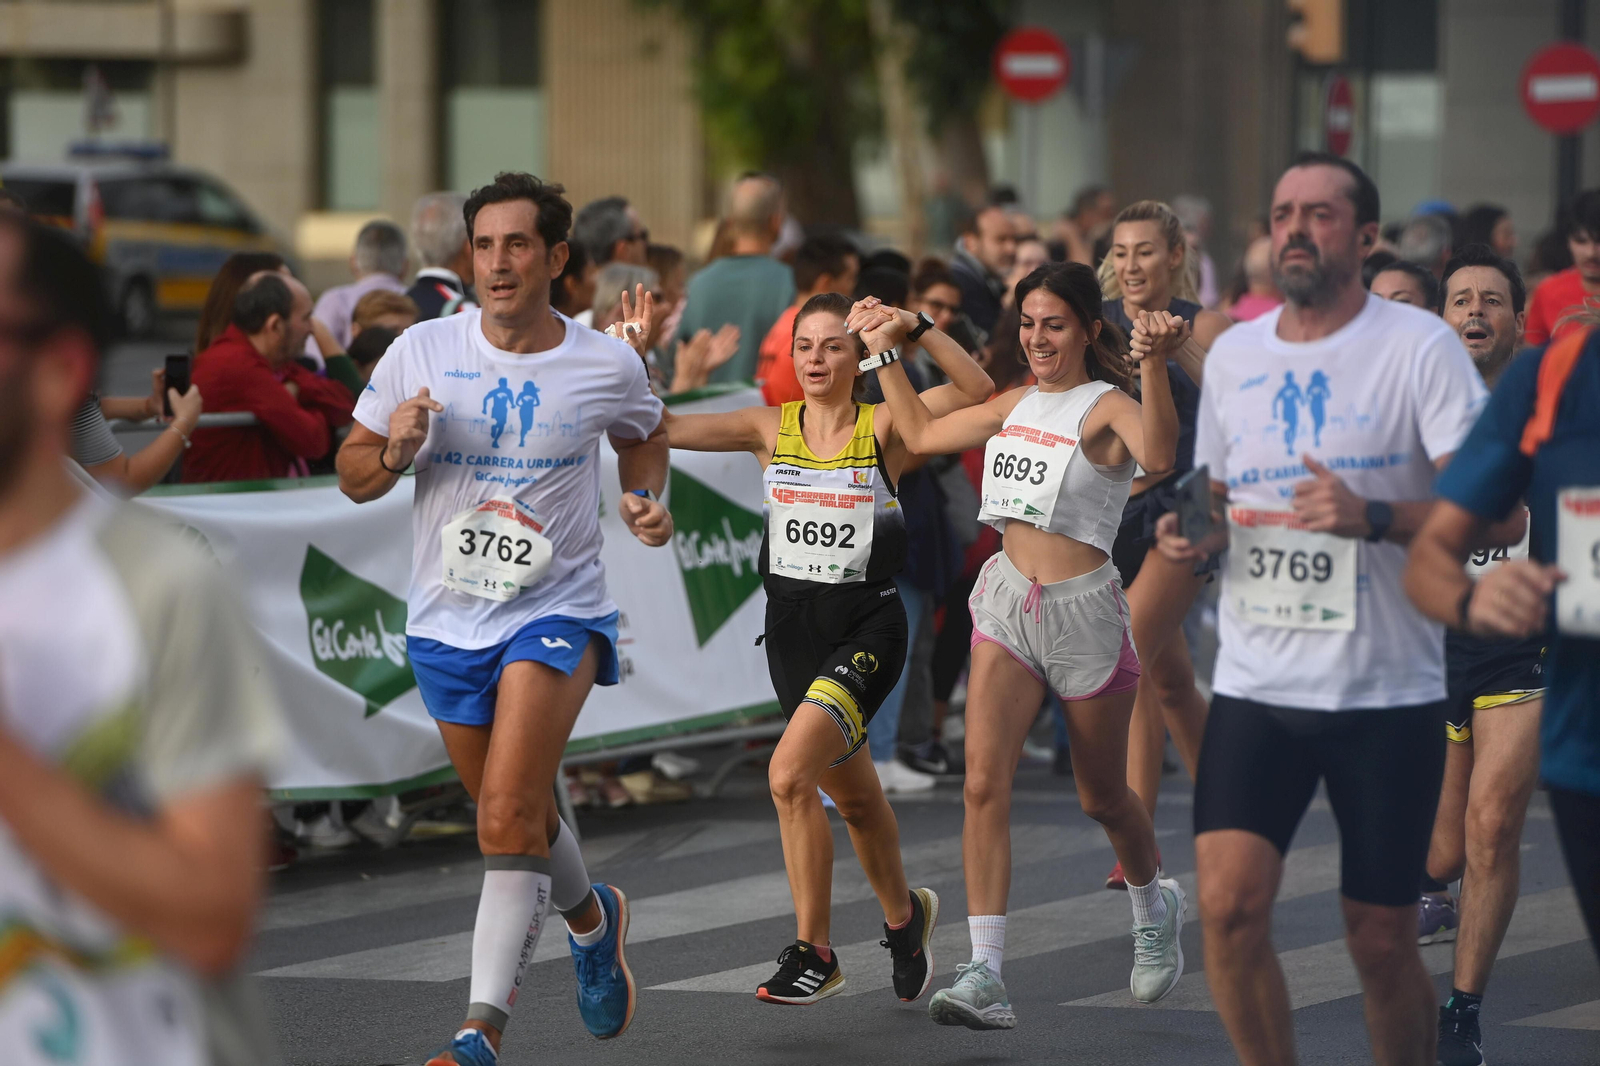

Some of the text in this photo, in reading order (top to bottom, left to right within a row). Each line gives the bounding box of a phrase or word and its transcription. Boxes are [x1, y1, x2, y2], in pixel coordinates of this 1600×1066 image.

[444, 369, 481, 380] málaga
[1009, 425, 1041, 437] CARRERA
[1042, 432, 1077, 447] URBANA
[1024, 435, 1056, 448] MALAGA
[444, 452, 575, 469] 42 CARRERA URBANA
[993, 452, 1048, 485] 6693
[772, 487, 874, 504] 42 CARRERA URBANA
[819, 500, 855, 509] MALAGA
[786, 519, 856, 549] 6692
[459, 529, 532, 566] 3762
[1247, 547, 1333, 583] 3769
[880, 587, 897, 598] FASTER
